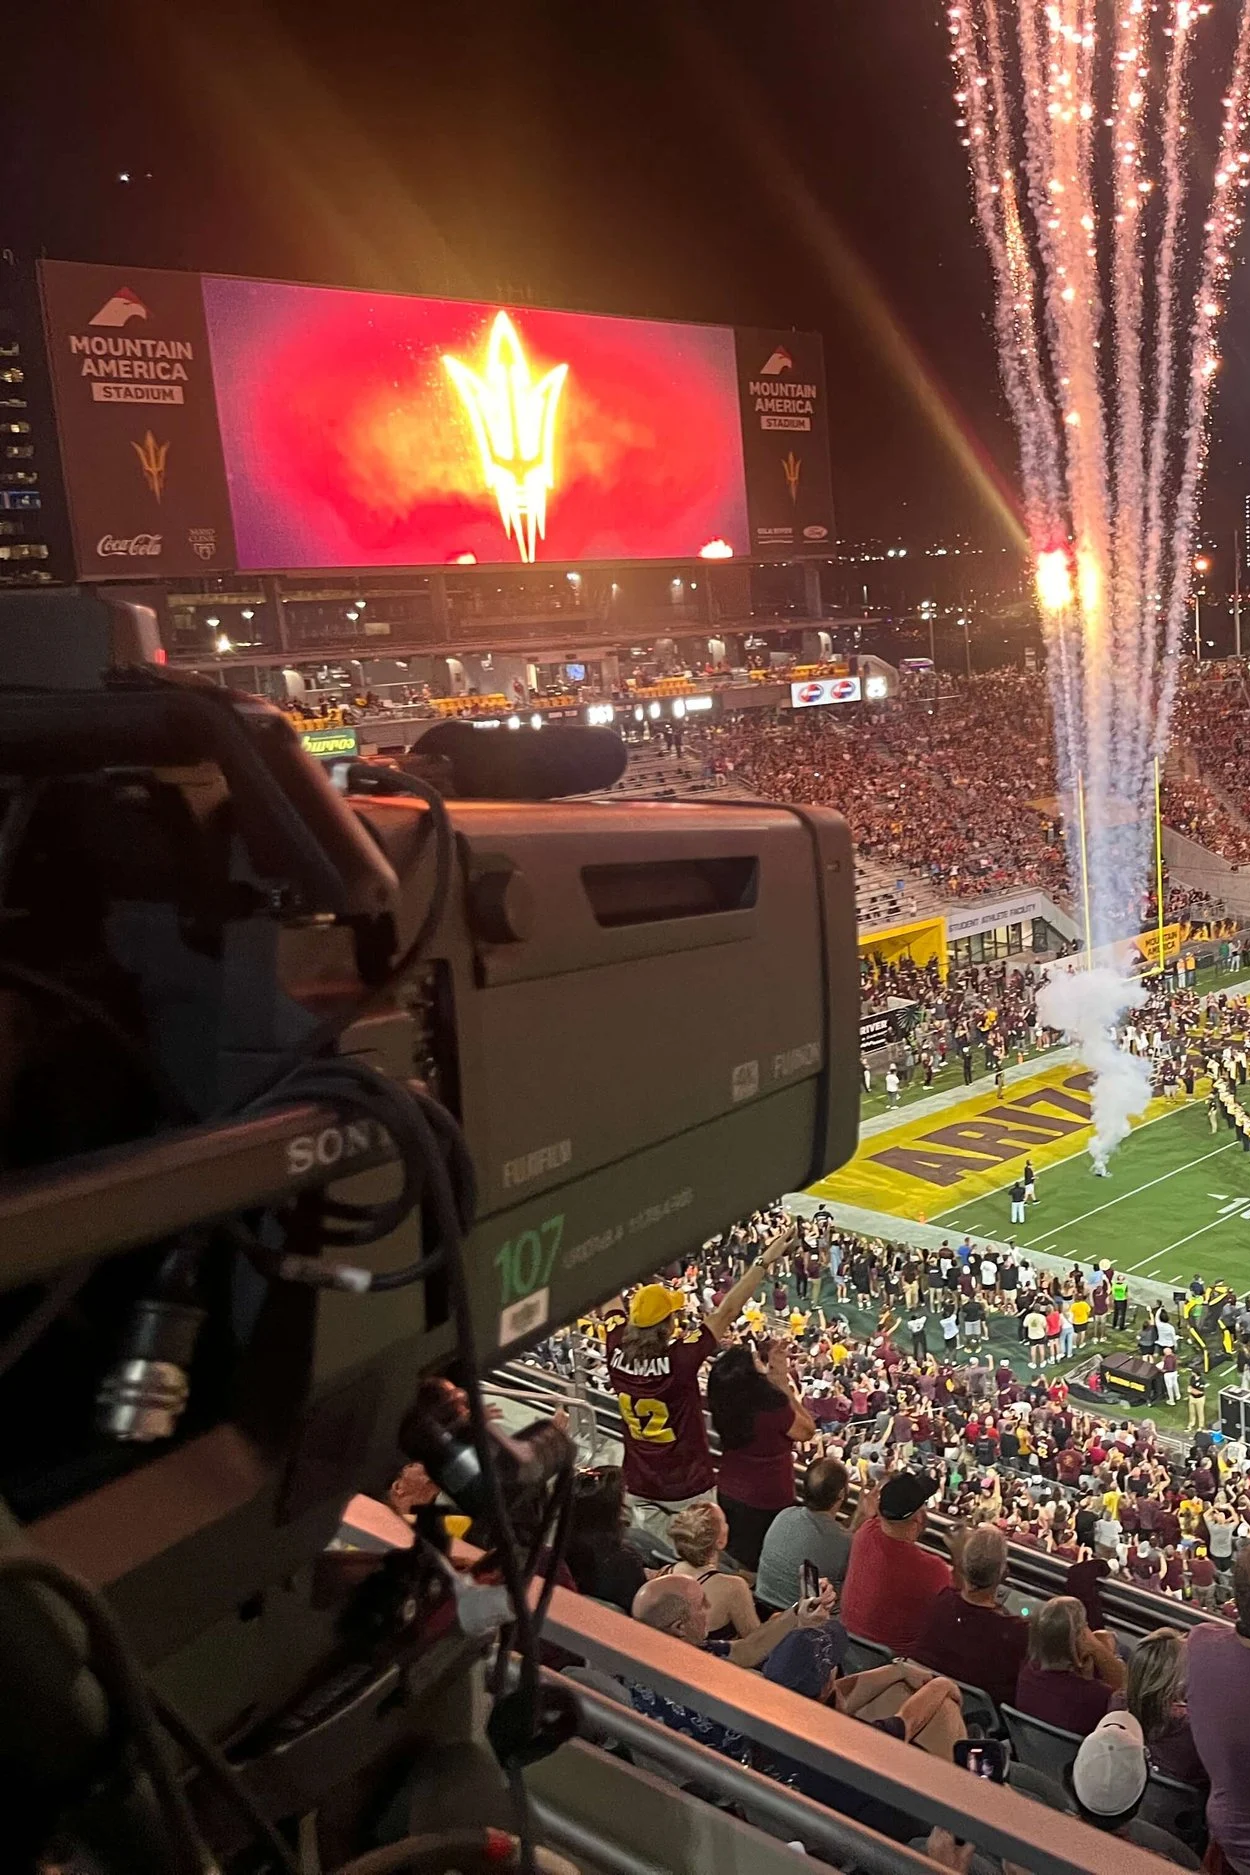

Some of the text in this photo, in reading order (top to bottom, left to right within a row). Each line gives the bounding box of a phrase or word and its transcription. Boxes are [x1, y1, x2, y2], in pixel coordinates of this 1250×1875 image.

[69, 335, 194, 360] MOUNTAIN
[81, 358, 189, 381] AMERICA
[102, 385, 176, 401] STADIUM
[749, 381, 817, 399] MOUNTAIN
[755, 398, 814, 414] AMERICA
[948, 918, 980, 933] STUDENT
[1010, 903, 1036, 917] FACILITY
[1145, 931, 1178, 947] MOUTAIN
[494, 1213, 566, 1306] 107
[610, 1347, 670, 1377] TILLMAN
[618, 1392, 677, 1443] 12
